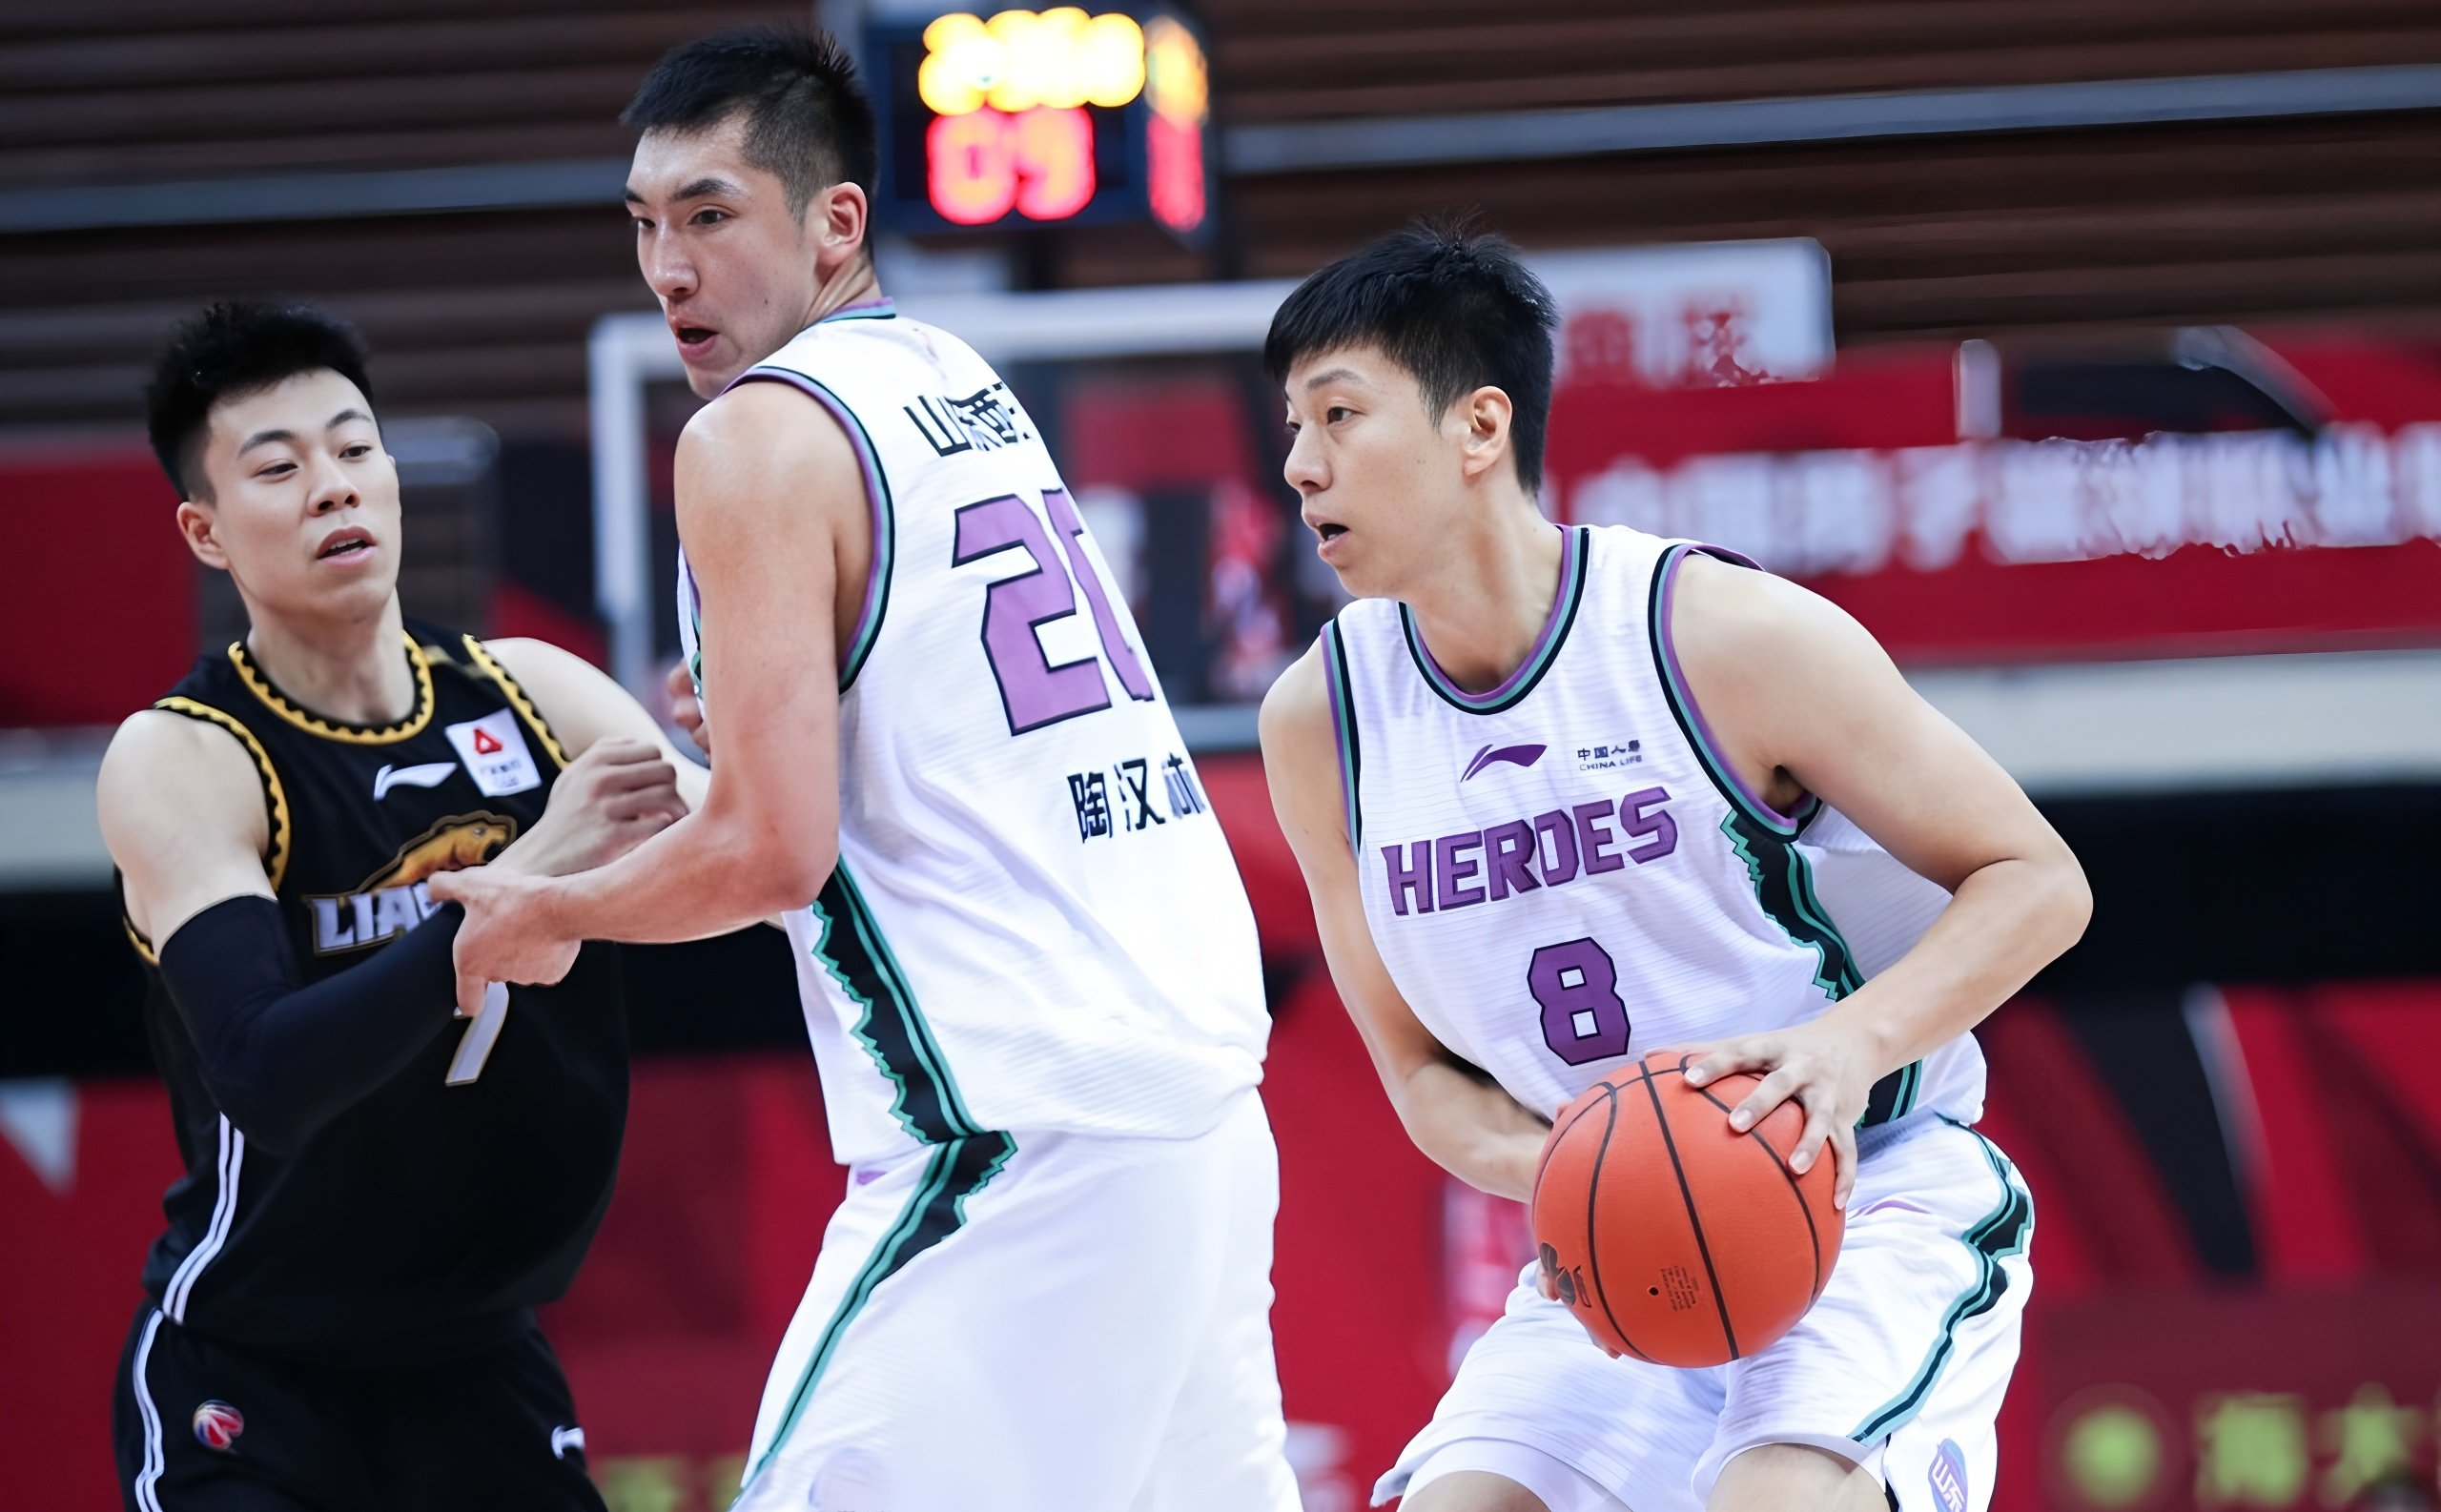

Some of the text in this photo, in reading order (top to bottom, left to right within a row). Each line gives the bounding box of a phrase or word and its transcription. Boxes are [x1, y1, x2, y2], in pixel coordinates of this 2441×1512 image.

[1580, 754, 1642, 771] CHINA LIFE
[1381, 786, 1678, 916] HEROES
[1527, 936, 1631, 1067] 8
